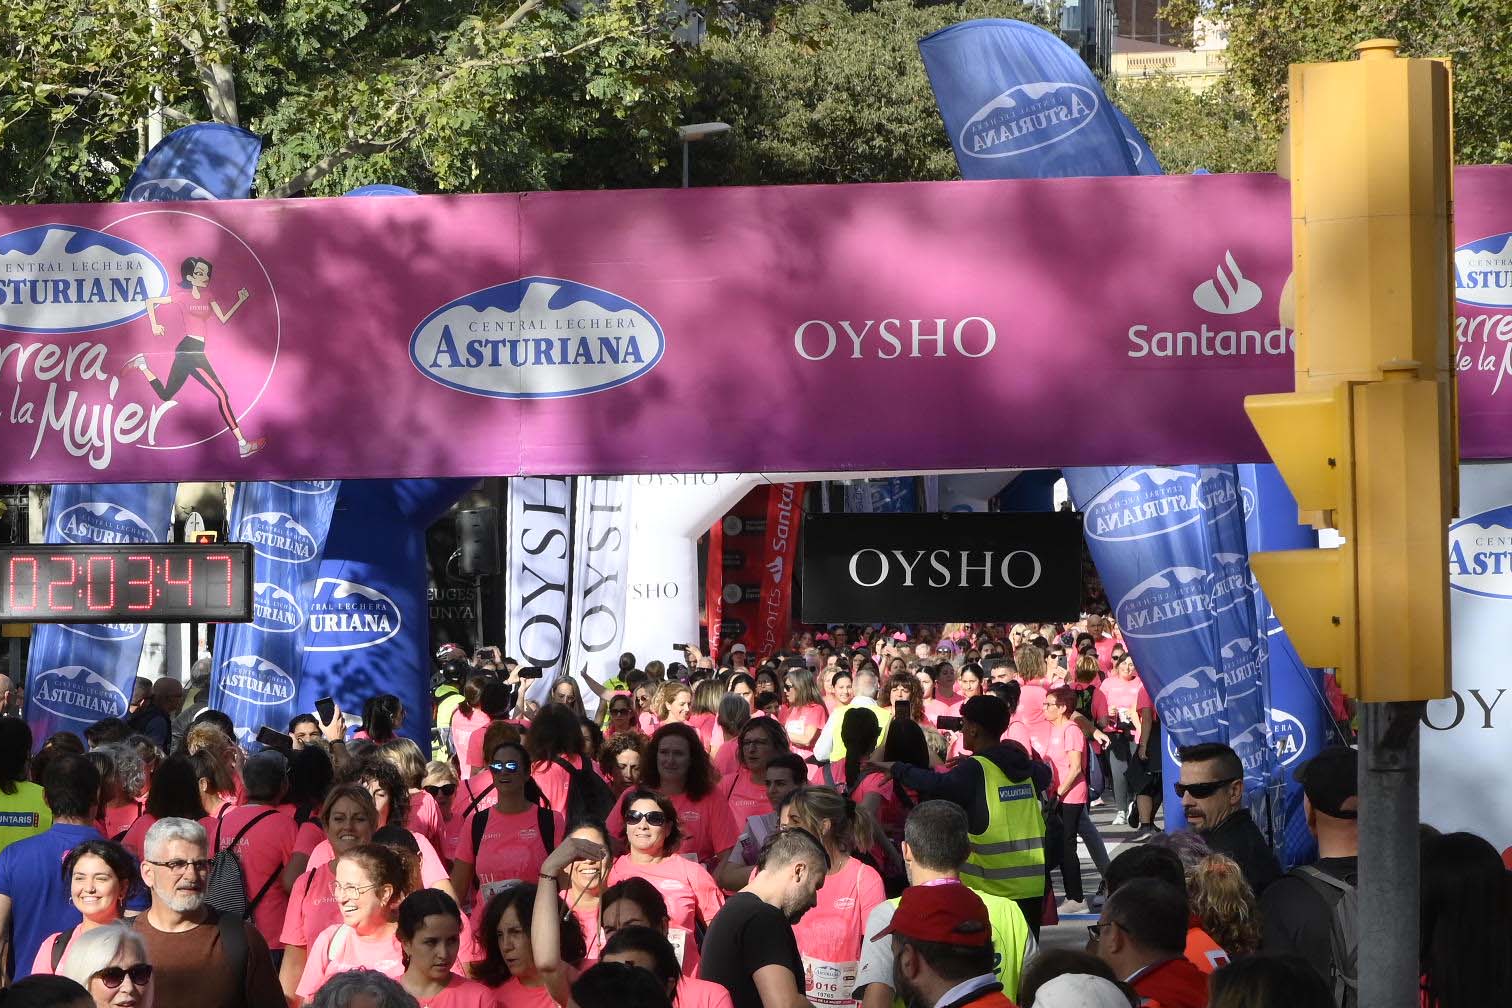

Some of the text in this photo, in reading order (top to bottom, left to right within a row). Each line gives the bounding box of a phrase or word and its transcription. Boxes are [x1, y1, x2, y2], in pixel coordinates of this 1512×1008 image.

[72, 260, 143, 271] LECHERA
[469, 318, 636, 332] CENTRAL LECHERA
[794, 316, 998, 361] OYSHO
[1127, 324, 1295, 358] Santand
[428, 324, 645, 369] ASTURIANA
[10, 387, 34, 425] la
[28, 376, 178, 470] Mujer
[241, 521, 310, 558] ASTURIANA
[9, 556, 232, 610] 02:03:47
[847, 548, 1043, 591] OYSHO
[309, 614, 392, 632] URIANA
[37, 678, 119, 717] ASTURIANA
[815, 981, 838, 992] 016
